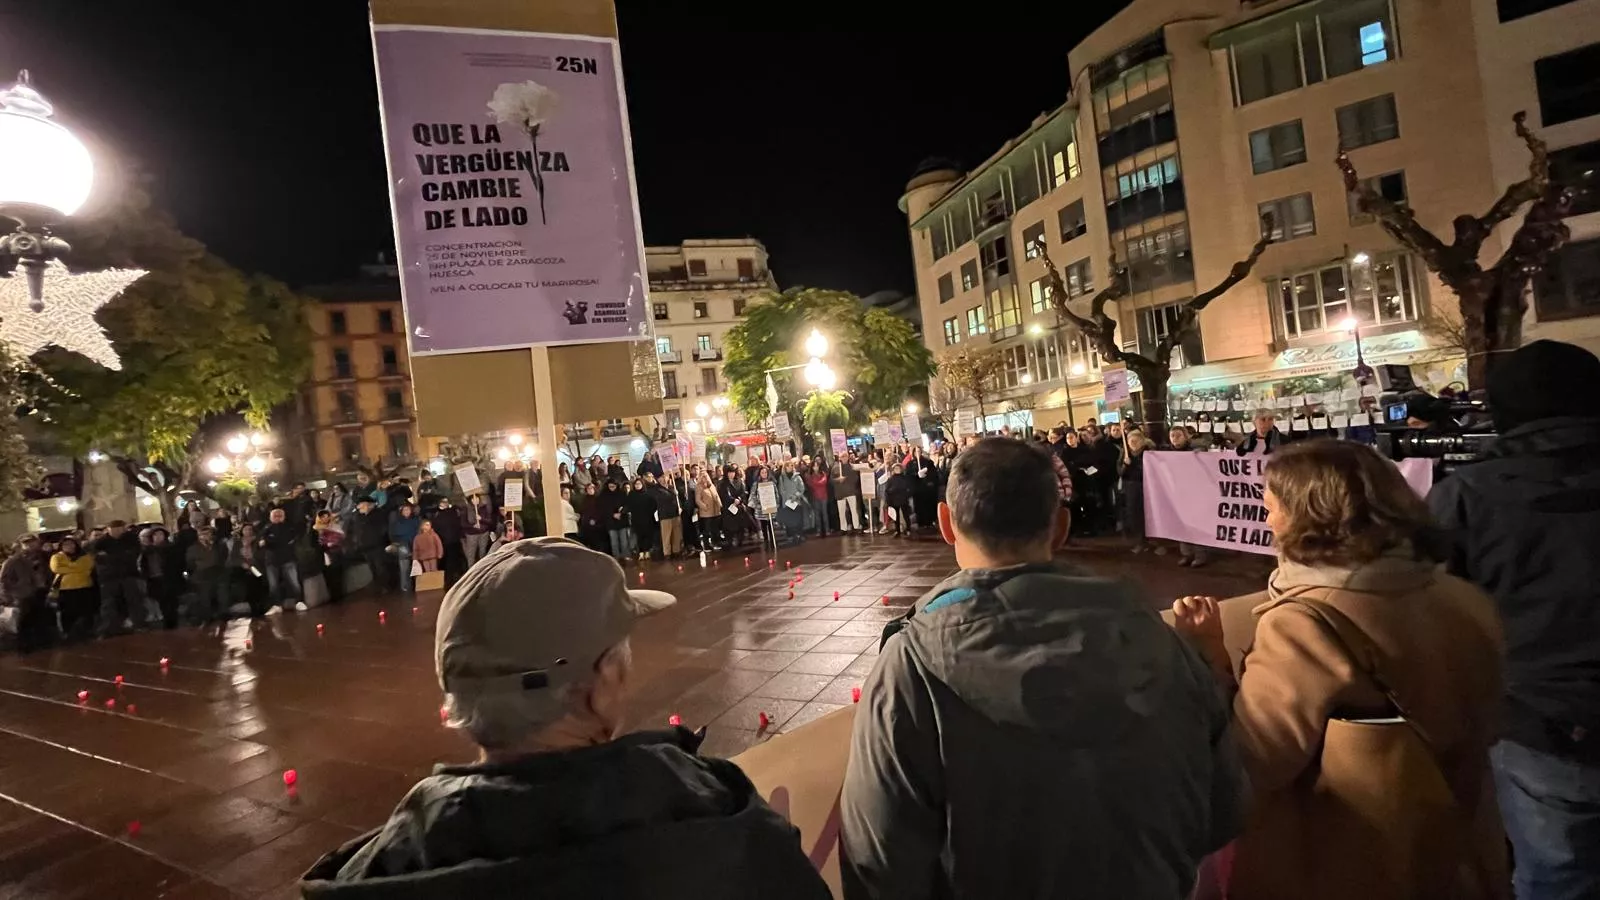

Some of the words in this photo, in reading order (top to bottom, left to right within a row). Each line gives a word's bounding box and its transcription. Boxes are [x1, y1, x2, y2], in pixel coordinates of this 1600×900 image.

[555, 56, 598, 75] 25N
[412, 123, 466, 147] QUE
[470, 123, 502, 144] LA
[415, 148, 570, 176] VERGÜENZA
[421, 178, 522, 202] CAMBIE
[424, 209, 456, 230] DE
[462, 206, 528, 228] LADO
[442, 252, 456, 260] DE
[460, 249, 528, 259] NOVIEMBRE
[449, 259, 486, 268] PLAZA
[488, 259, 503, 267] DE
[506, 257, 566, 266] ZARAGOZA
[429, 269, 475, 279] HUESCA
[469, 281, 523, 291] COLOCAR
[1218, 458, 1252, 477] QUE
[1217, 502, 1270, 522] CAMB
[1216, 524, 1237, 543] DE
[1240, 528, 1274, 547] LAD
